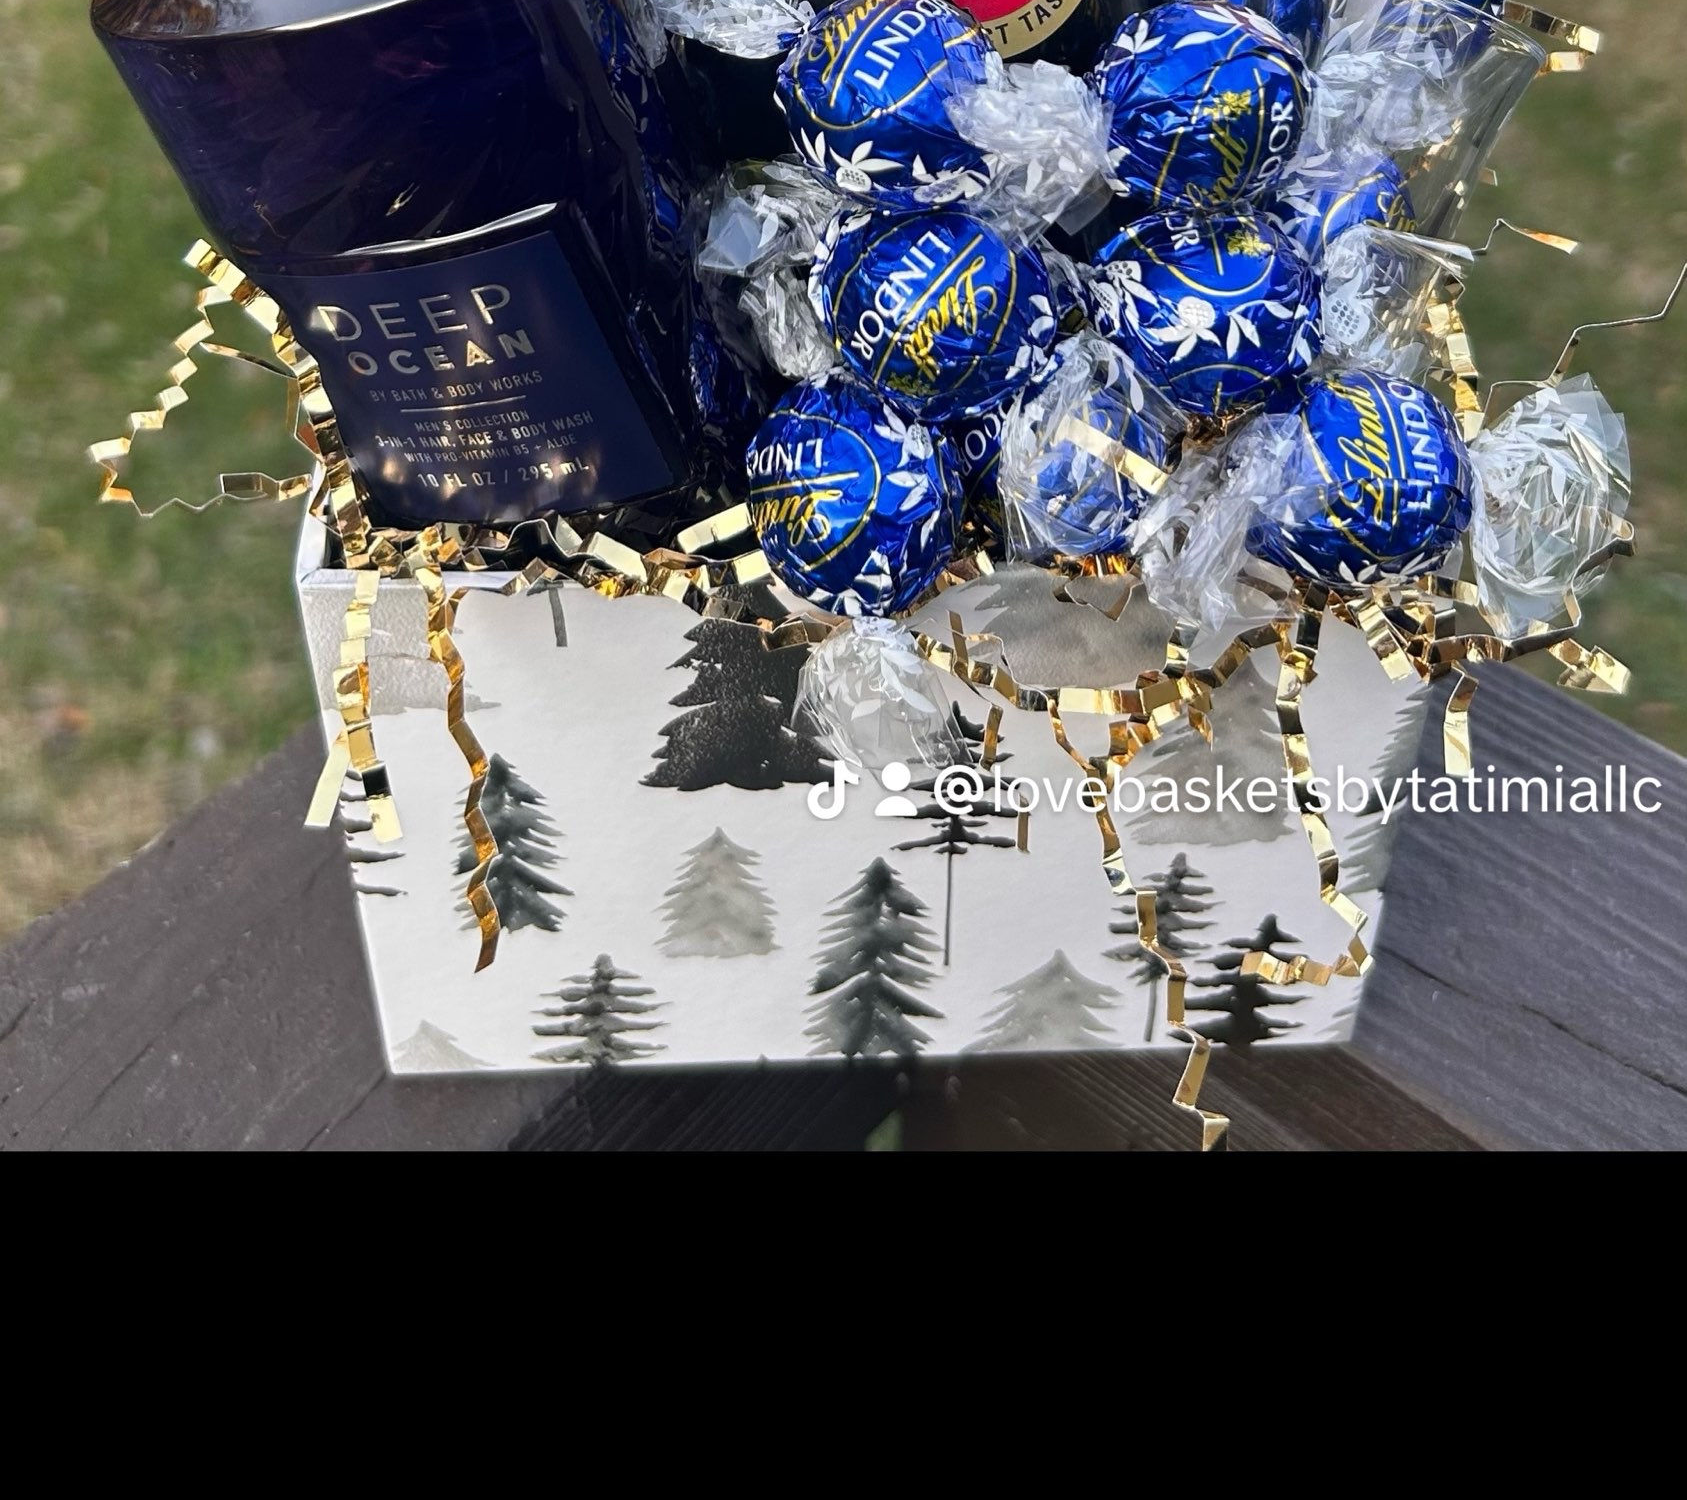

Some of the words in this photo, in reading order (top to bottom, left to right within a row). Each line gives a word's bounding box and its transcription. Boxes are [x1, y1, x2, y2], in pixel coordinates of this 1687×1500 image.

[316, 283, 513, 342] DEEP
[851, 229, 951, 361] LINDOR
[903, 255, 998, 383] Lindt
[347, 328, 536, 377] OCEAN
[369, 388, 389, 403] BY
[391, 386, 427, 403] BATH
[433, 385, 444, 400] &
[447, 380, 485, 399] BODY
[489, 369, 544, 393] WORKS
[374, 434, 416, 450] 3-IN-1
[459, 429, 494, 448] FACE
[497, 427, 508, 442] &
[510, 421, 548, 440] BODY
[552, 409, 595, 434] WASH
[414, 417, 452, 434] MEN'S
[454, 408, 530, 431] COLLECTION
[403, 450, 432, 465] WITH
[434, 445, 510, 464] PRO-VITAMIN
[513, 441, 530, 456] B5
[546, 432, 578, 451] ALOE
[746, 438, 823, 477] LINDO
[1387, 380, 1440, 510] LINDO
[417, 471, 440, 489] 10
[444, 472, 467, 489] FL
[471, 470, 497, 488] OZ
[520, 462, 554, 482] 295
[561, 455, 591, 476] mL
